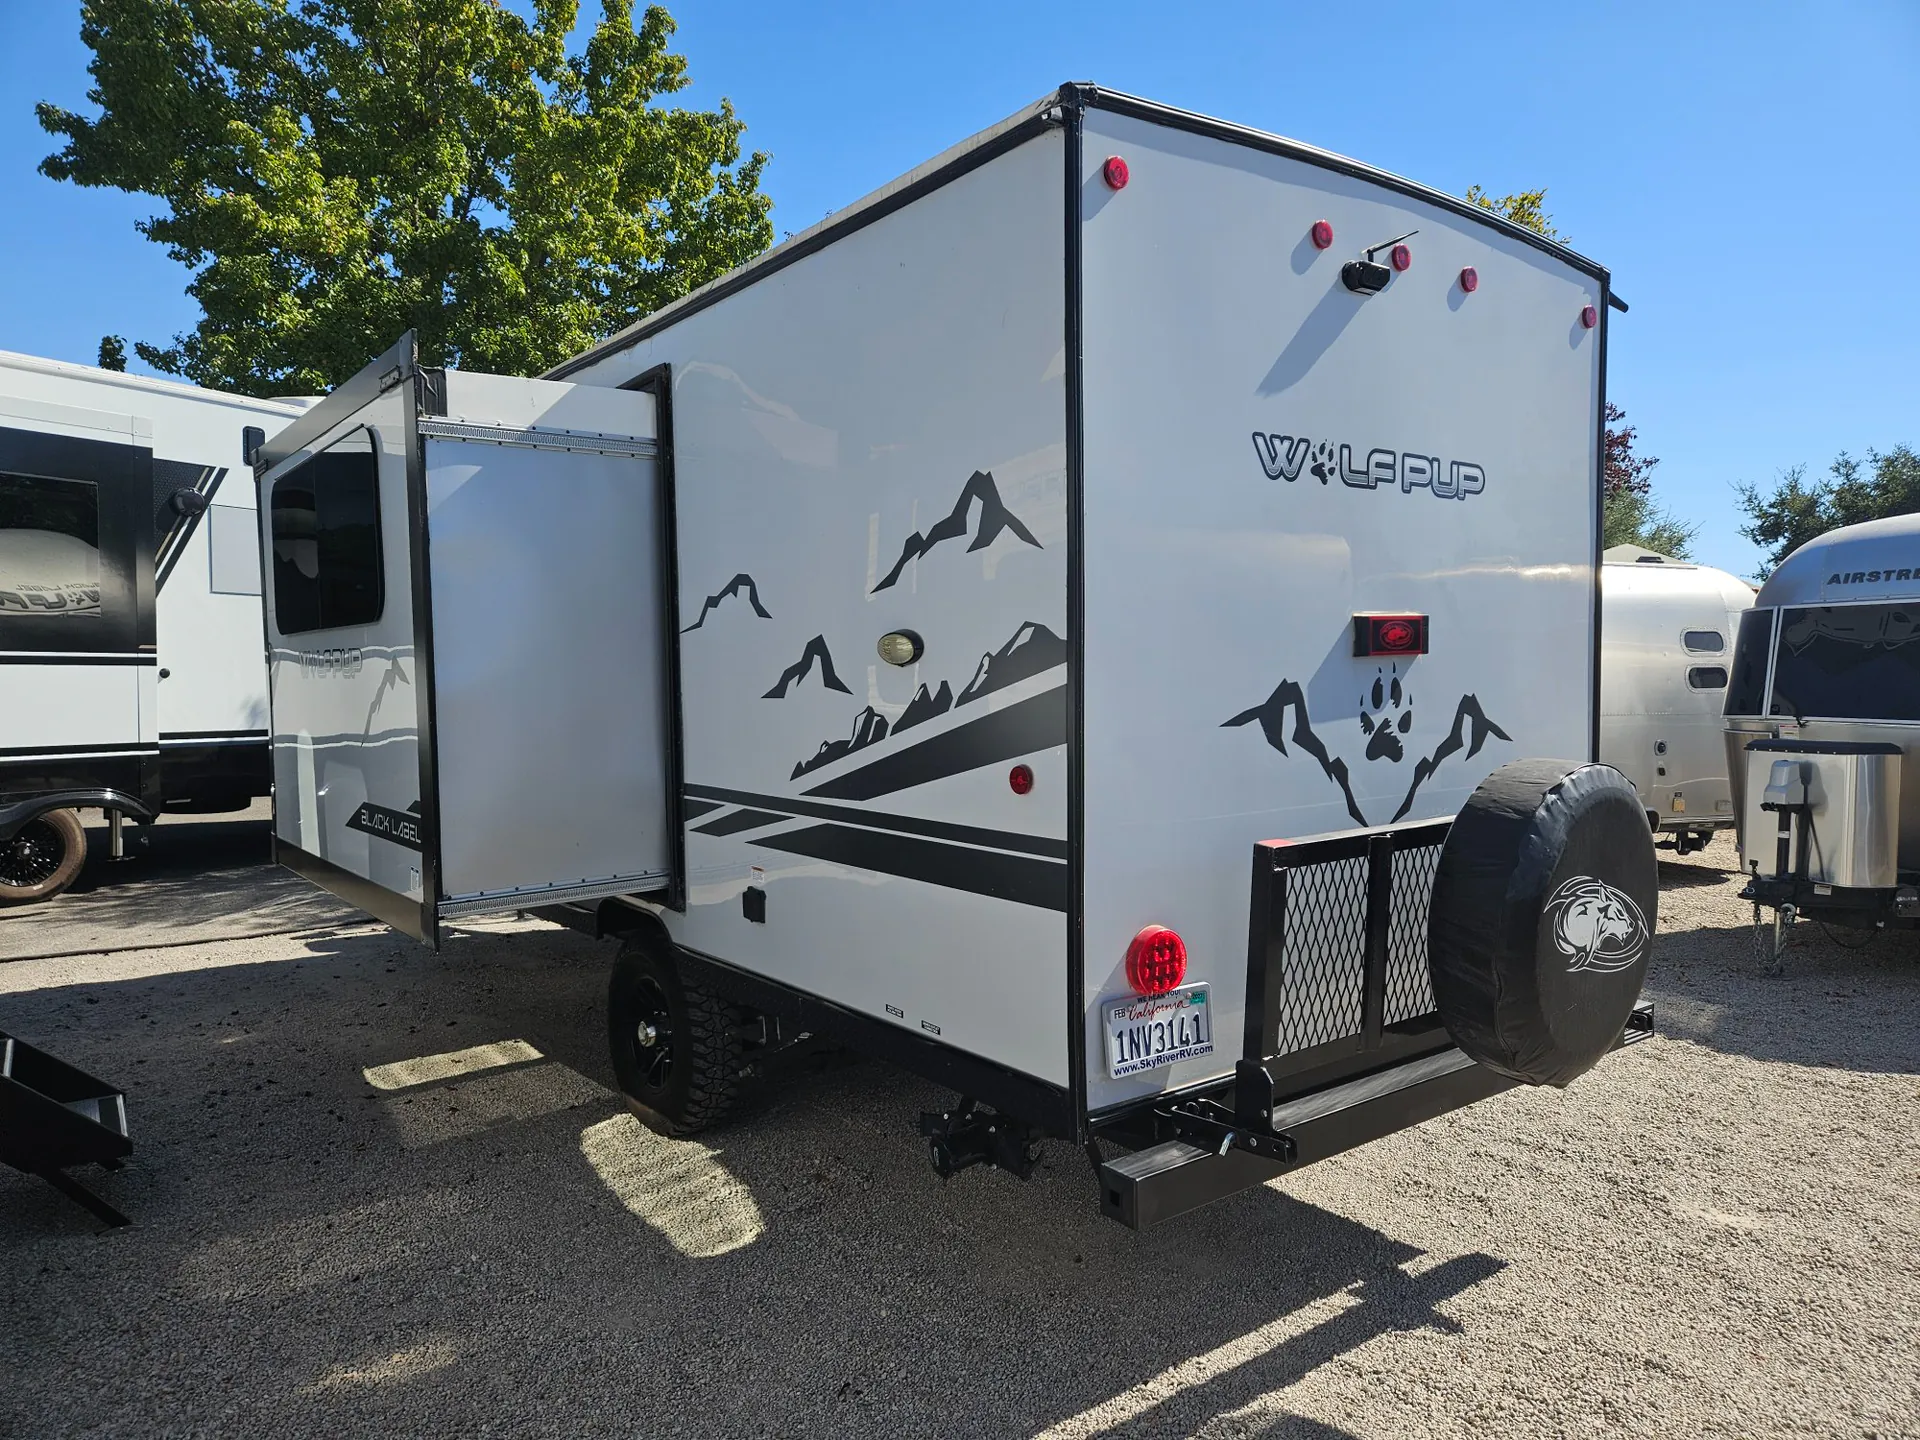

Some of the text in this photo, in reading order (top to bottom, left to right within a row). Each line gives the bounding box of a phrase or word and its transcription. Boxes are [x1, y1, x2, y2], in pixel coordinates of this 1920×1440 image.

[361, 809, 421, 843] BLACK LABEL
[1114, 1009, 1126, 1020] FEB
[1128, 1000, 1190, 1022] California
[1117, 1013, 1205, 1064] 1NV3141
[1114, 1045, 1213, 1076] www.SkyRiverRV.com
